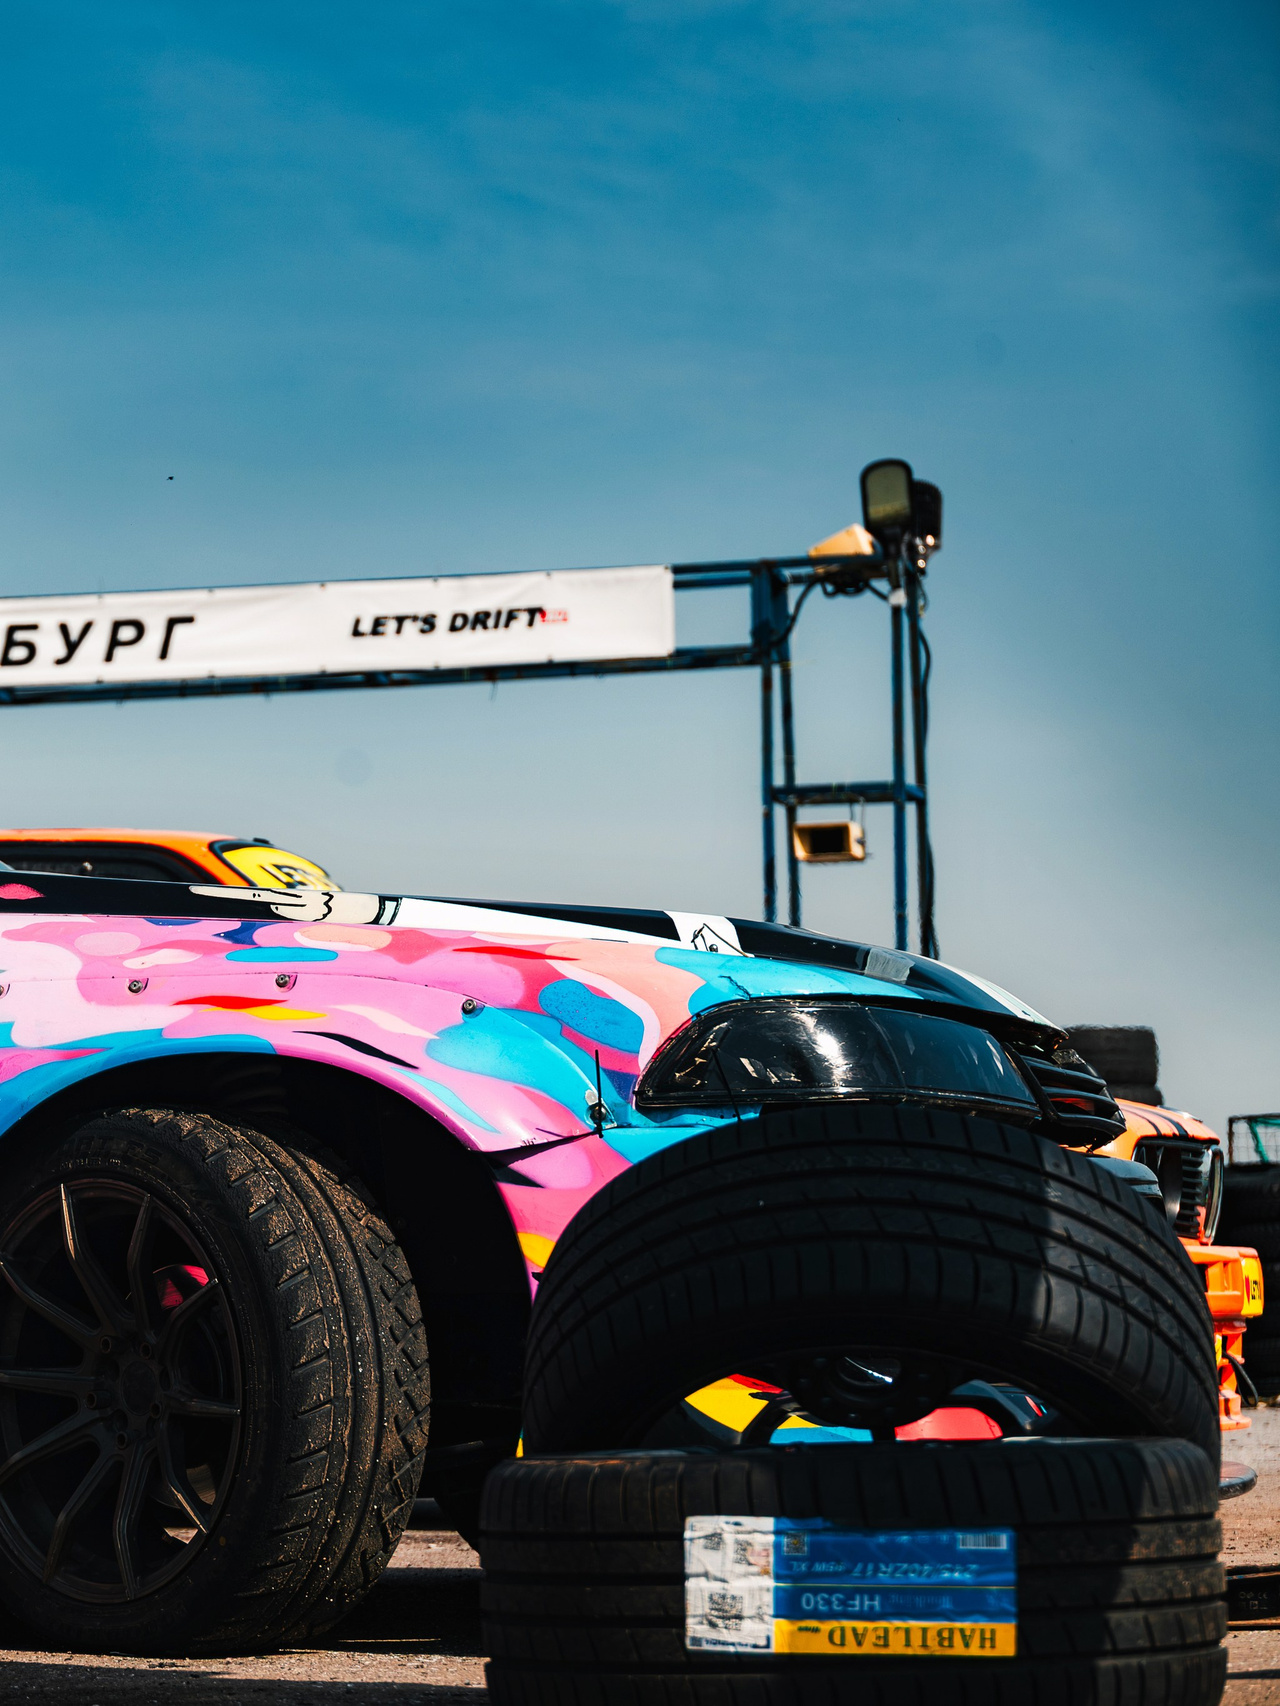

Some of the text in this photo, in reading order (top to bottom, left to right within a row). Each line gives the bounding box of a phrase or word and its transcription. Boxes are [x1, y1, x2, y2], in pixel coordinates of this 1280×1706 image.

[351, 613, 437, 637] LET'S
[448, 606, 545, 632] DRIFT
[801, 1592, 880, 1611] HF330
[827, 1625, 997, 1650] HABILEAD
